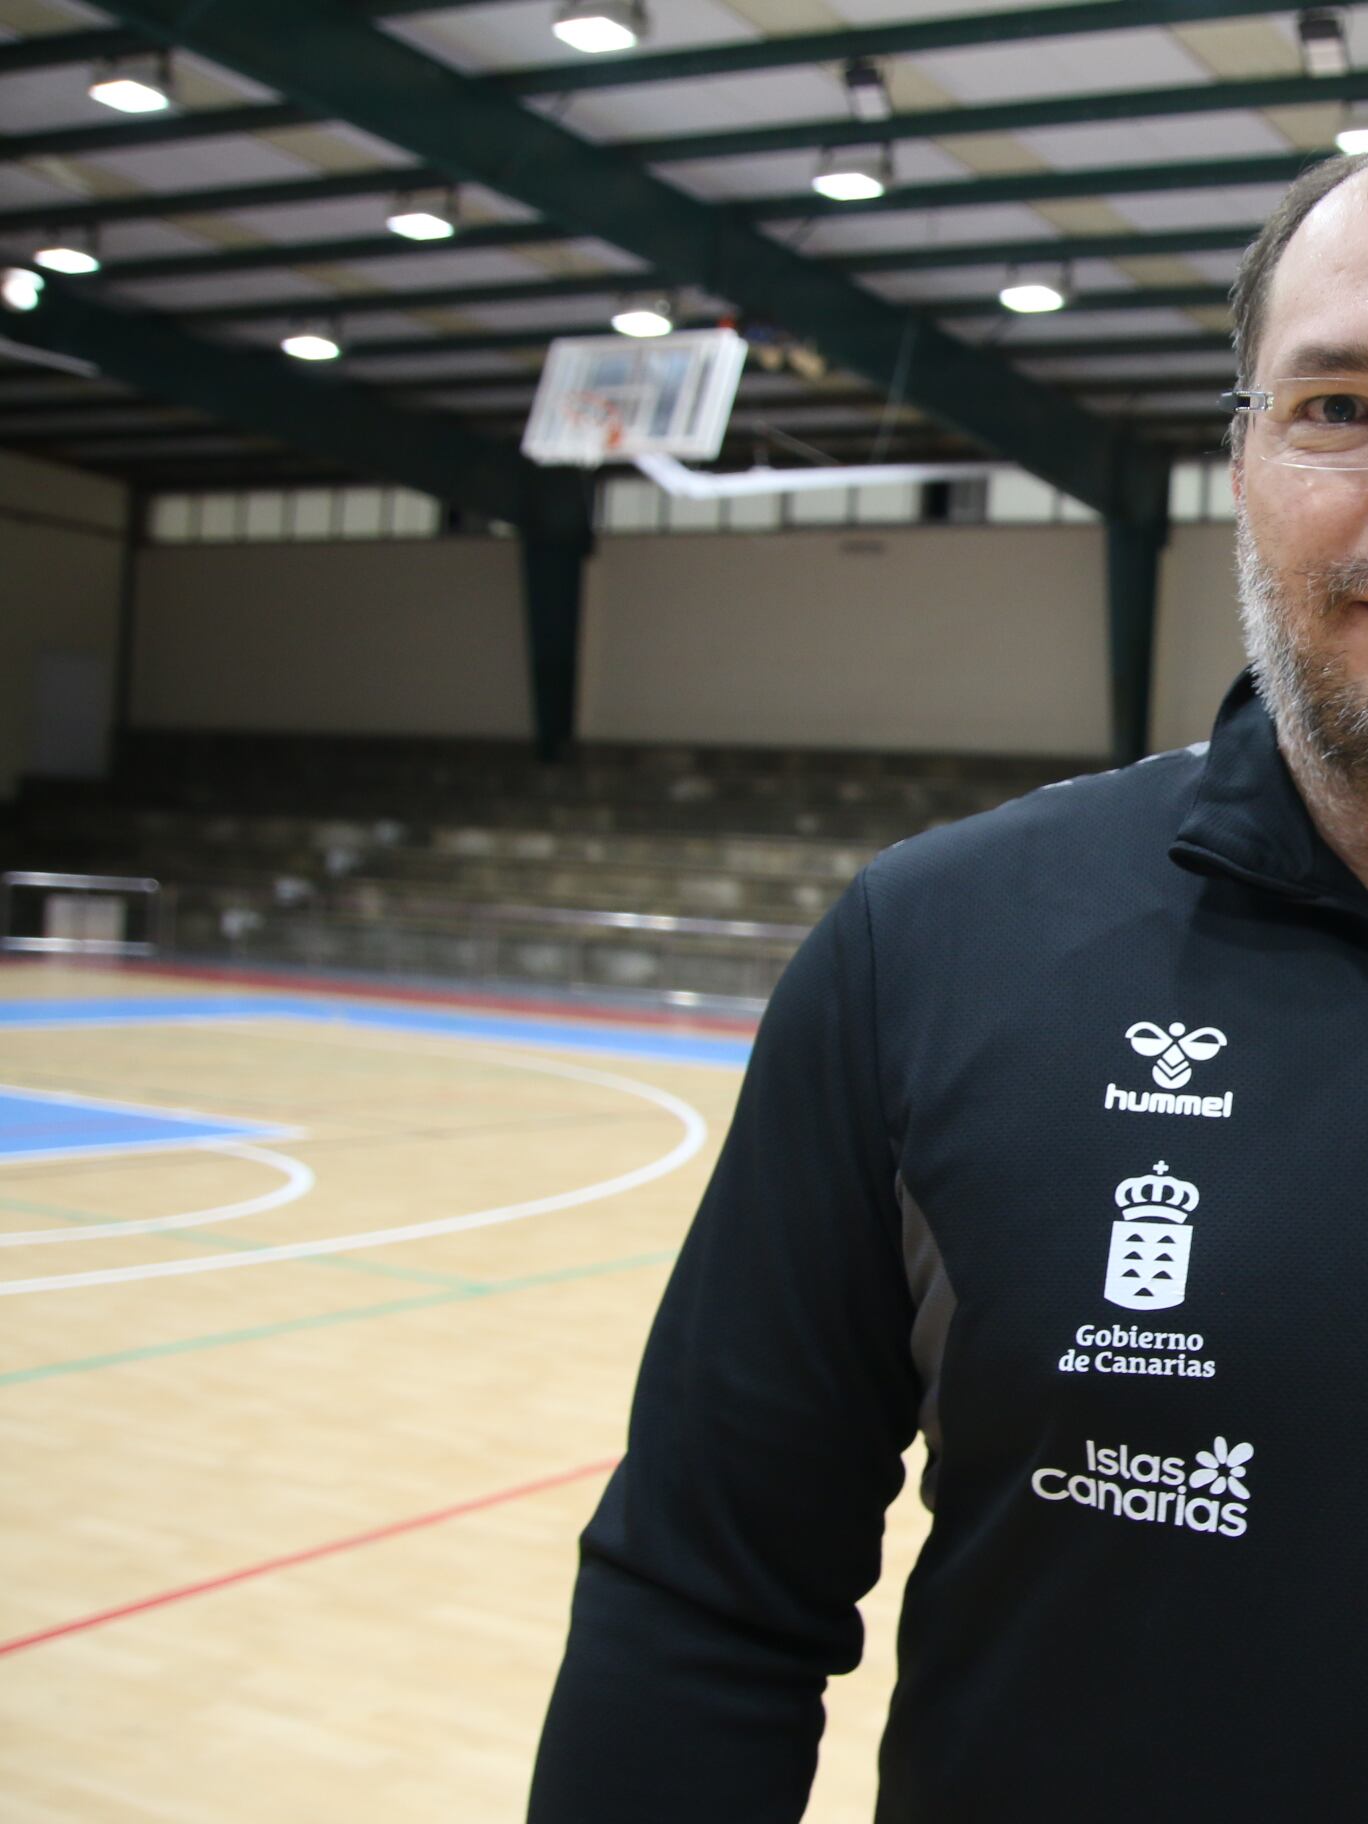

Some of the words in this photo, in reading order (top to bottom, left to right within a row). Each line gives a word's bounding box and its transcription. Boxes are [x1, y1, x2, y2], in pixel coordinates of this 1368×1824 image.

[1104, 1083, 1234, 1118] hummel
[1075, 1324, 1204, 1351] Gobierno
[1058, 1349, 1090, 1372] de
[1095, 1351, 1216, 1378] Canarias
[1086, 1440, 1186, 1486] Islas
[1031, 1467, 1248, 1537] Canarias
